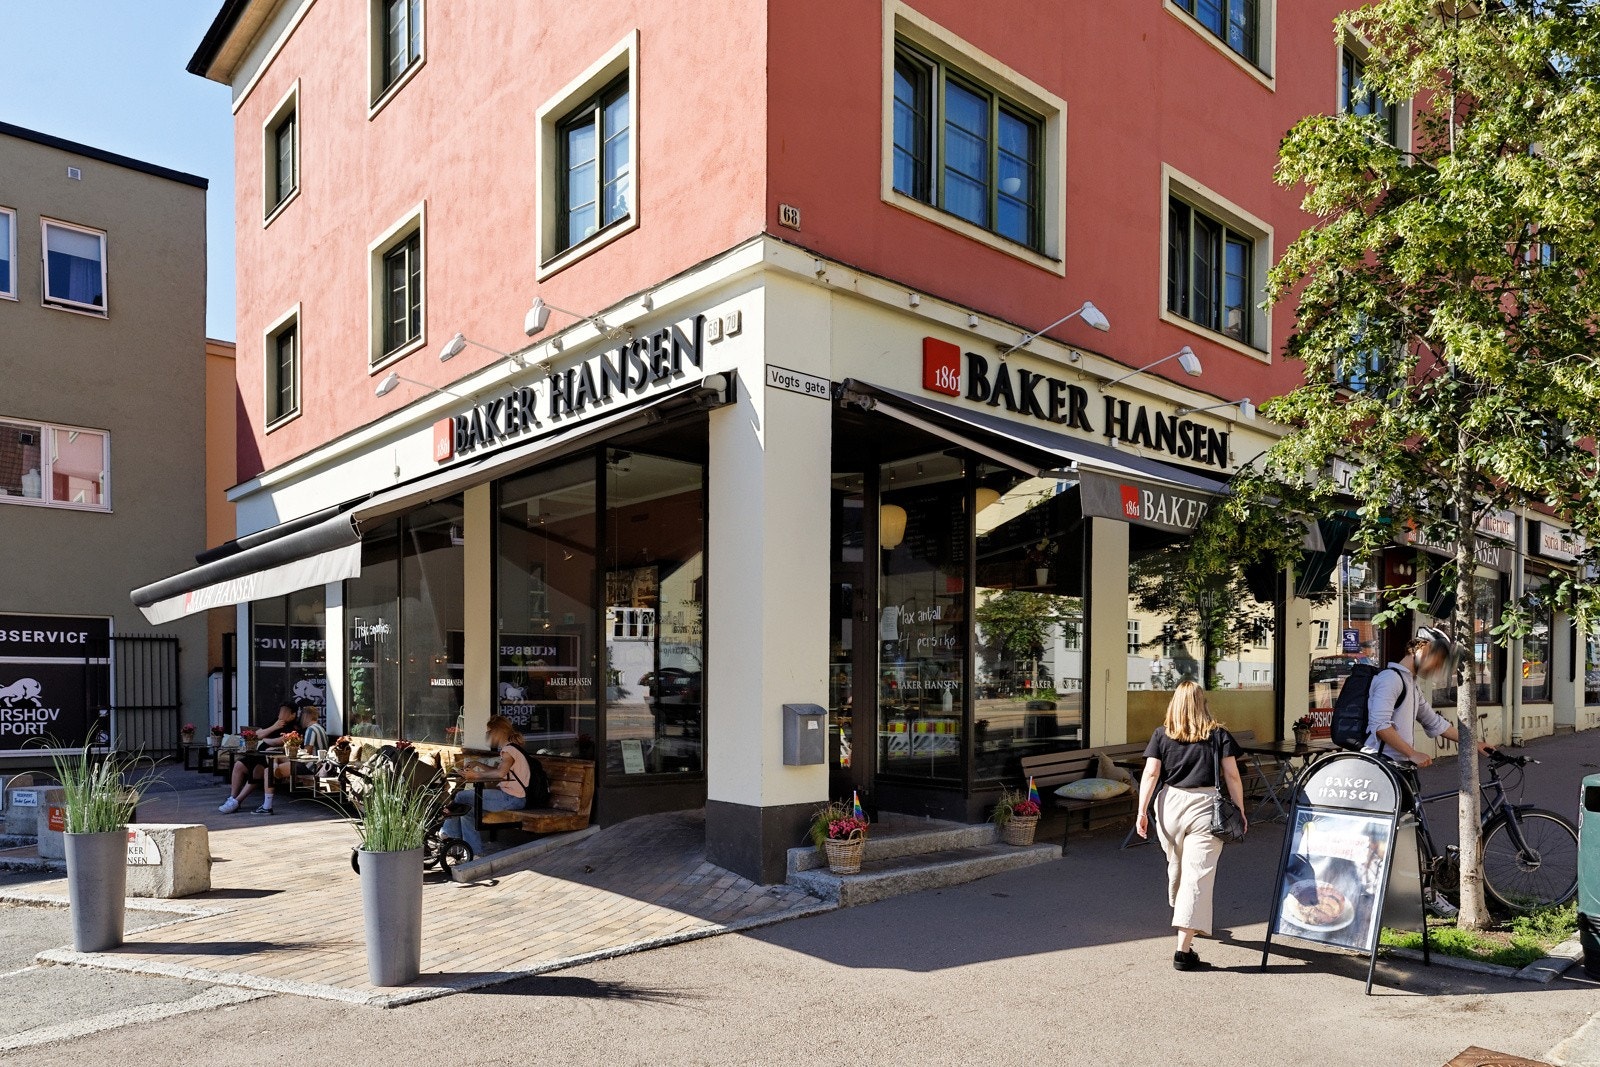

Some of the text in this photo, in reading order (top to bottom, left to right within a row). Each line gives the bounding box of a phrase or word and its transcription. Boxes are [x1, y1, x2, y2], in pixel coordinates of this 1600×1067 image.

[782, 206, 798, 225] 68
[453, 314, 707, 453] BAKER HANSEN
[771, 370, 826, 395] Vogts gate
[935, 365, 960, 391] 1861
[964, 352, 1229, 468] BAKER HANSEN
[1125, 500, 1139, 517] 1861
[895, 605, 915, 625] Max
[917, 606, 942, 622] antall
[550, 678, 593, 686] BAKER HANSEN
[897, 680, 959, 689] BAKER HANSEN
[0, 708, 60, 721] RSHOV
[1309, 711, 1334, 728] ORSHO
[0, 722, 48, 736] PORT
